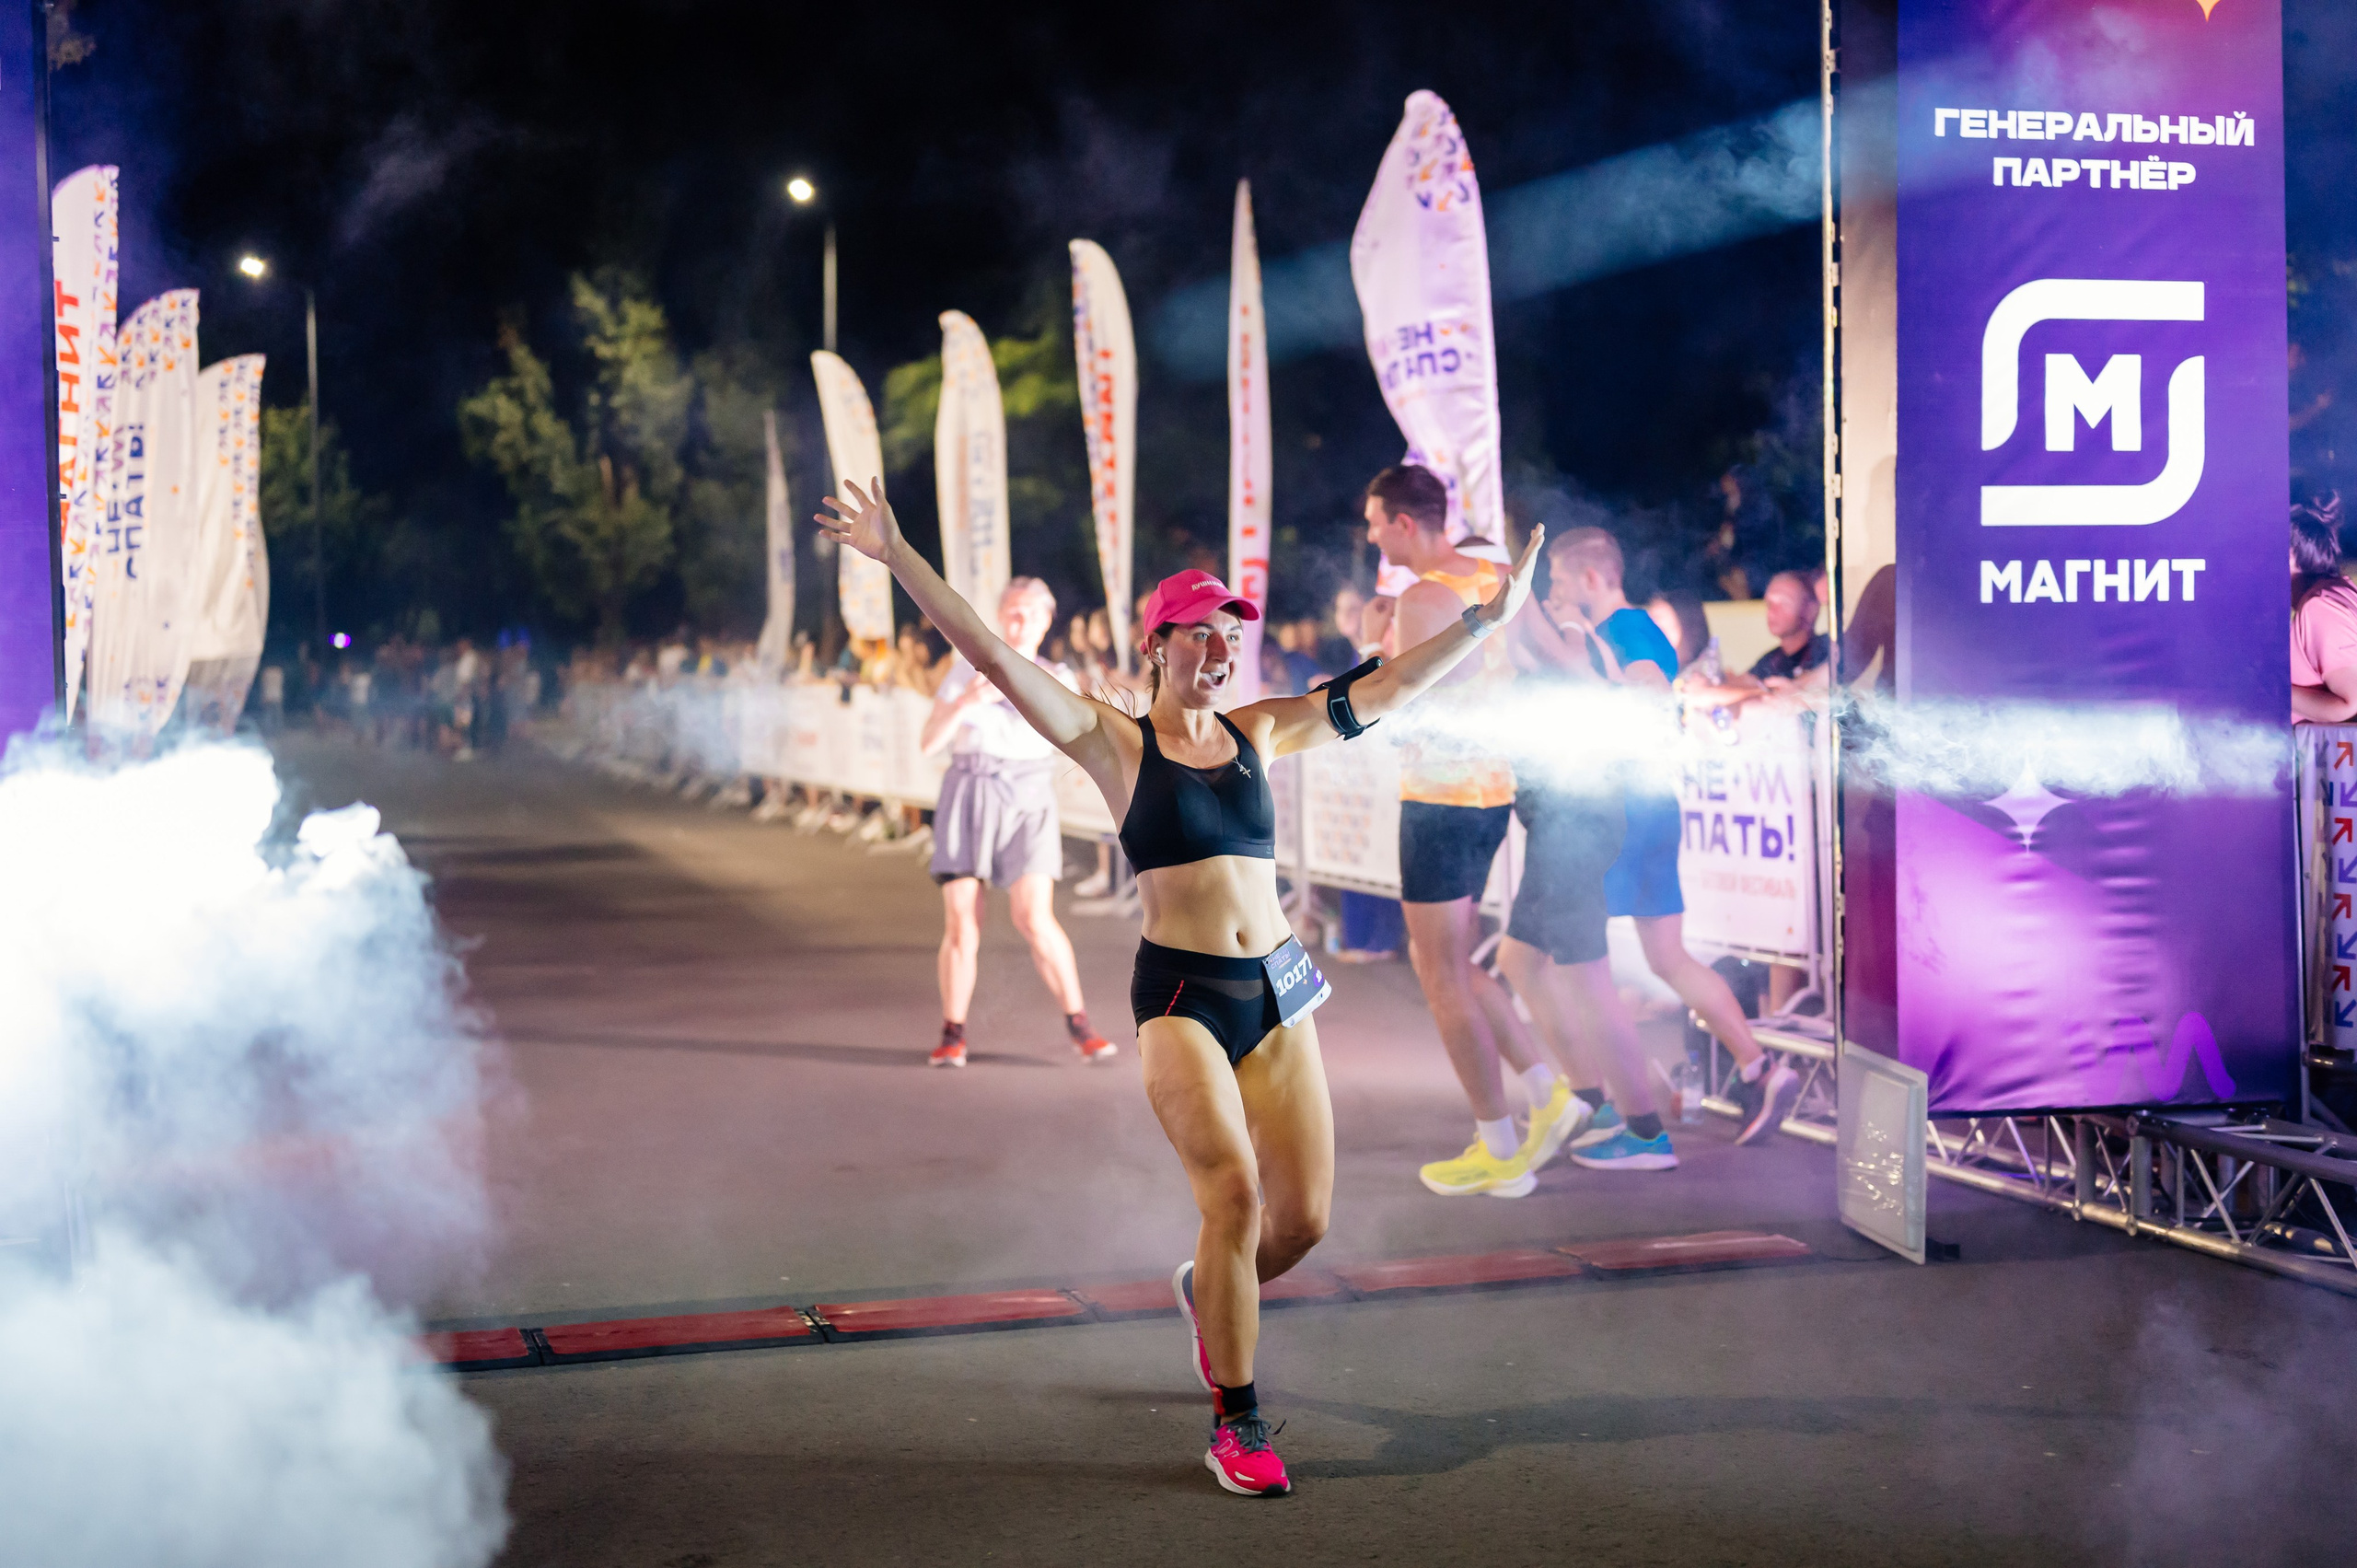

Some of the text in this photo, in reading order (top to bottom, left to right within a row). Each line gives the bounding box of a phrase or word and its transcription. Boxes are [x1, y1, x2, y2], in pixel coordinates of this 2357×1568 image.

[1934, 108, 2255, 146] ГЕНЕРАЛЬНЫЙ
[1992, 156, 2196, 191] ПАРТНЁР
[1980, 559, 2206, 603] МАГНИТ
[1683, 810, 1794, 862] ПАТЬ!
